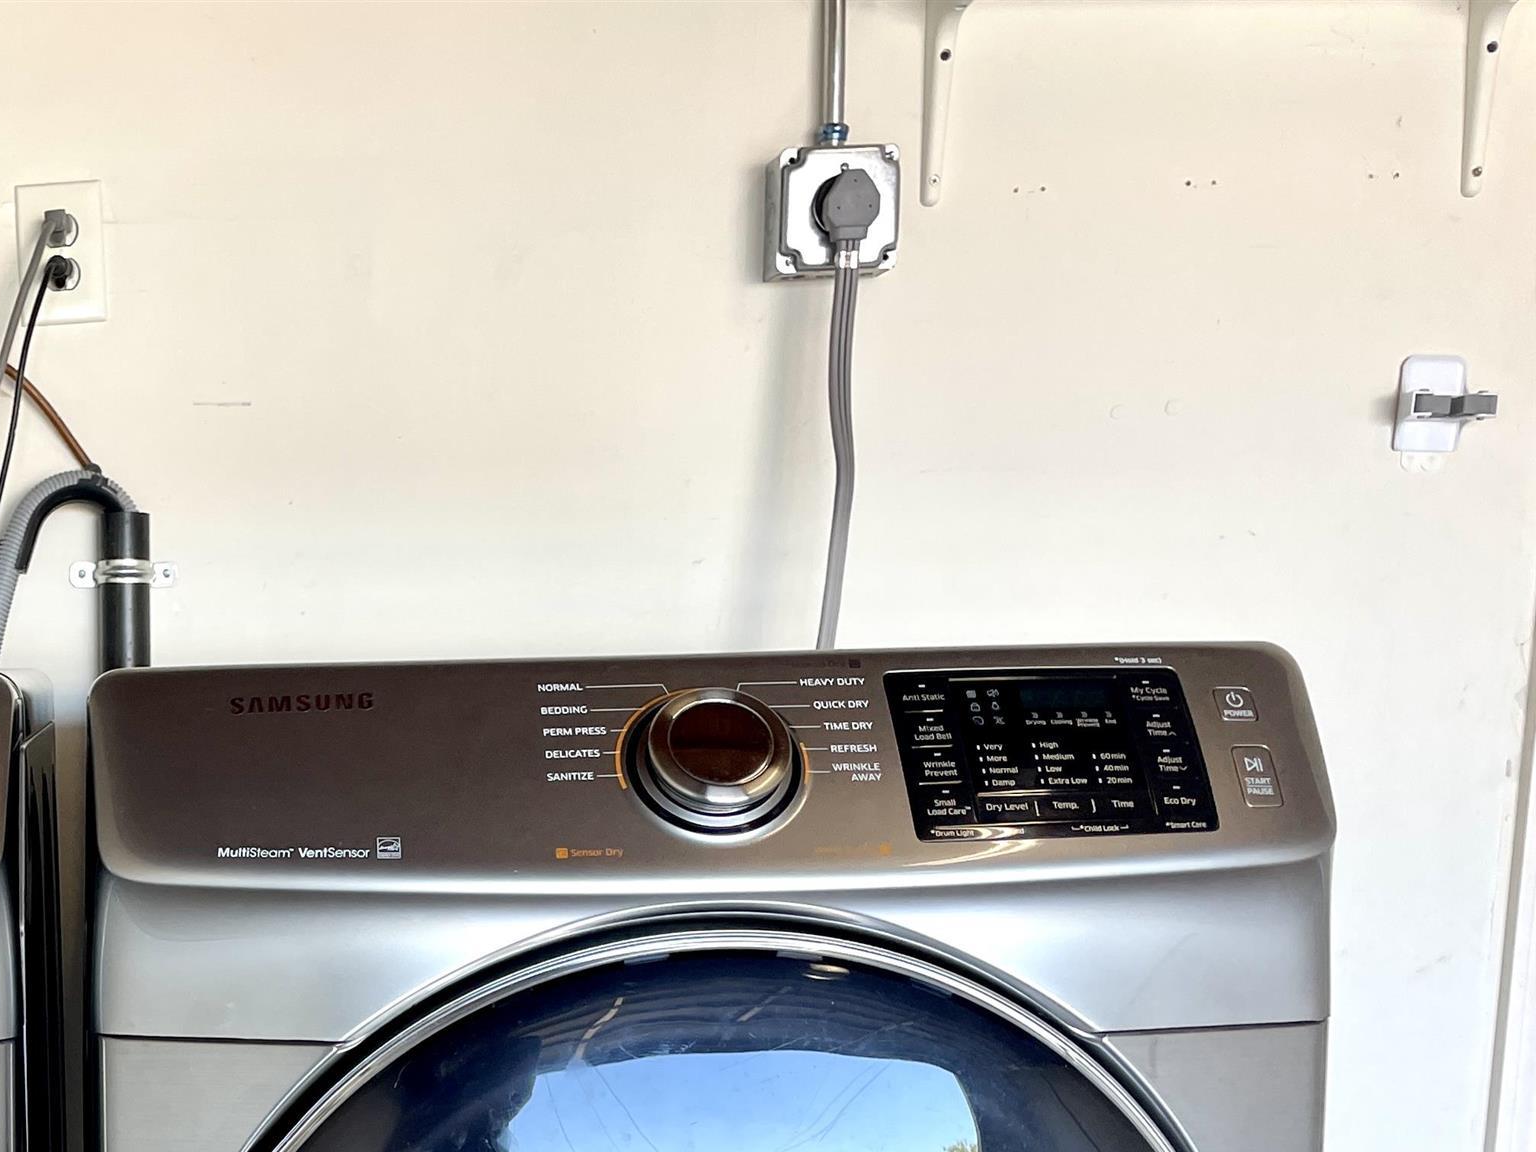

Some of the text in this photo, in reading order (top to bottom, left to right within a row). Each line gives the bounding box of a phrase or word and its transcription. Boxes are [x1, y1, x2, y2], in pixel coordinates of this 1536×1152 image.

[800, 678, 834, 686] HEAVY
[537, 683, 583, 692] NORMAL
[1130, 687, 1144, 695] My
[230, 692, 374, 716] SAMSUNG
[813, 700, 869, 710] QUICK DRY
[540, 706, 587, 715] BEDDING
[824, 722, 873, 730] TIME DRY
[1146, 721, 1171, 729] Adjust
[543, 727, 606, 736] PERM PRESS
[830, 745, 877, 753] REFRESH
[984, 743, 1003, 751] Very
[1039, 741, 1059, 749] High
[545, 749, 600, 758] DELICATES
[1158, 756, 1182, 764] Adjust
[832, 763, 880, 771] WRINKLE
[547, 772, 594, 781] SANITIZE
[852, 773, 881, 781] AWAY
[925, 769, 957, 777] Prevent
[934, 799, 956, 807] Small
[1053, 801, 1079, 809] Temp.
[1111, 800, 1134, 808] Time
[1164, 797, 1196, 806] Eco Dry
[986, 803, 1002, 812] Dry
[298, 847, 370, 858] VentSensor
[570, 848, 624, 857] Sensor Dry
